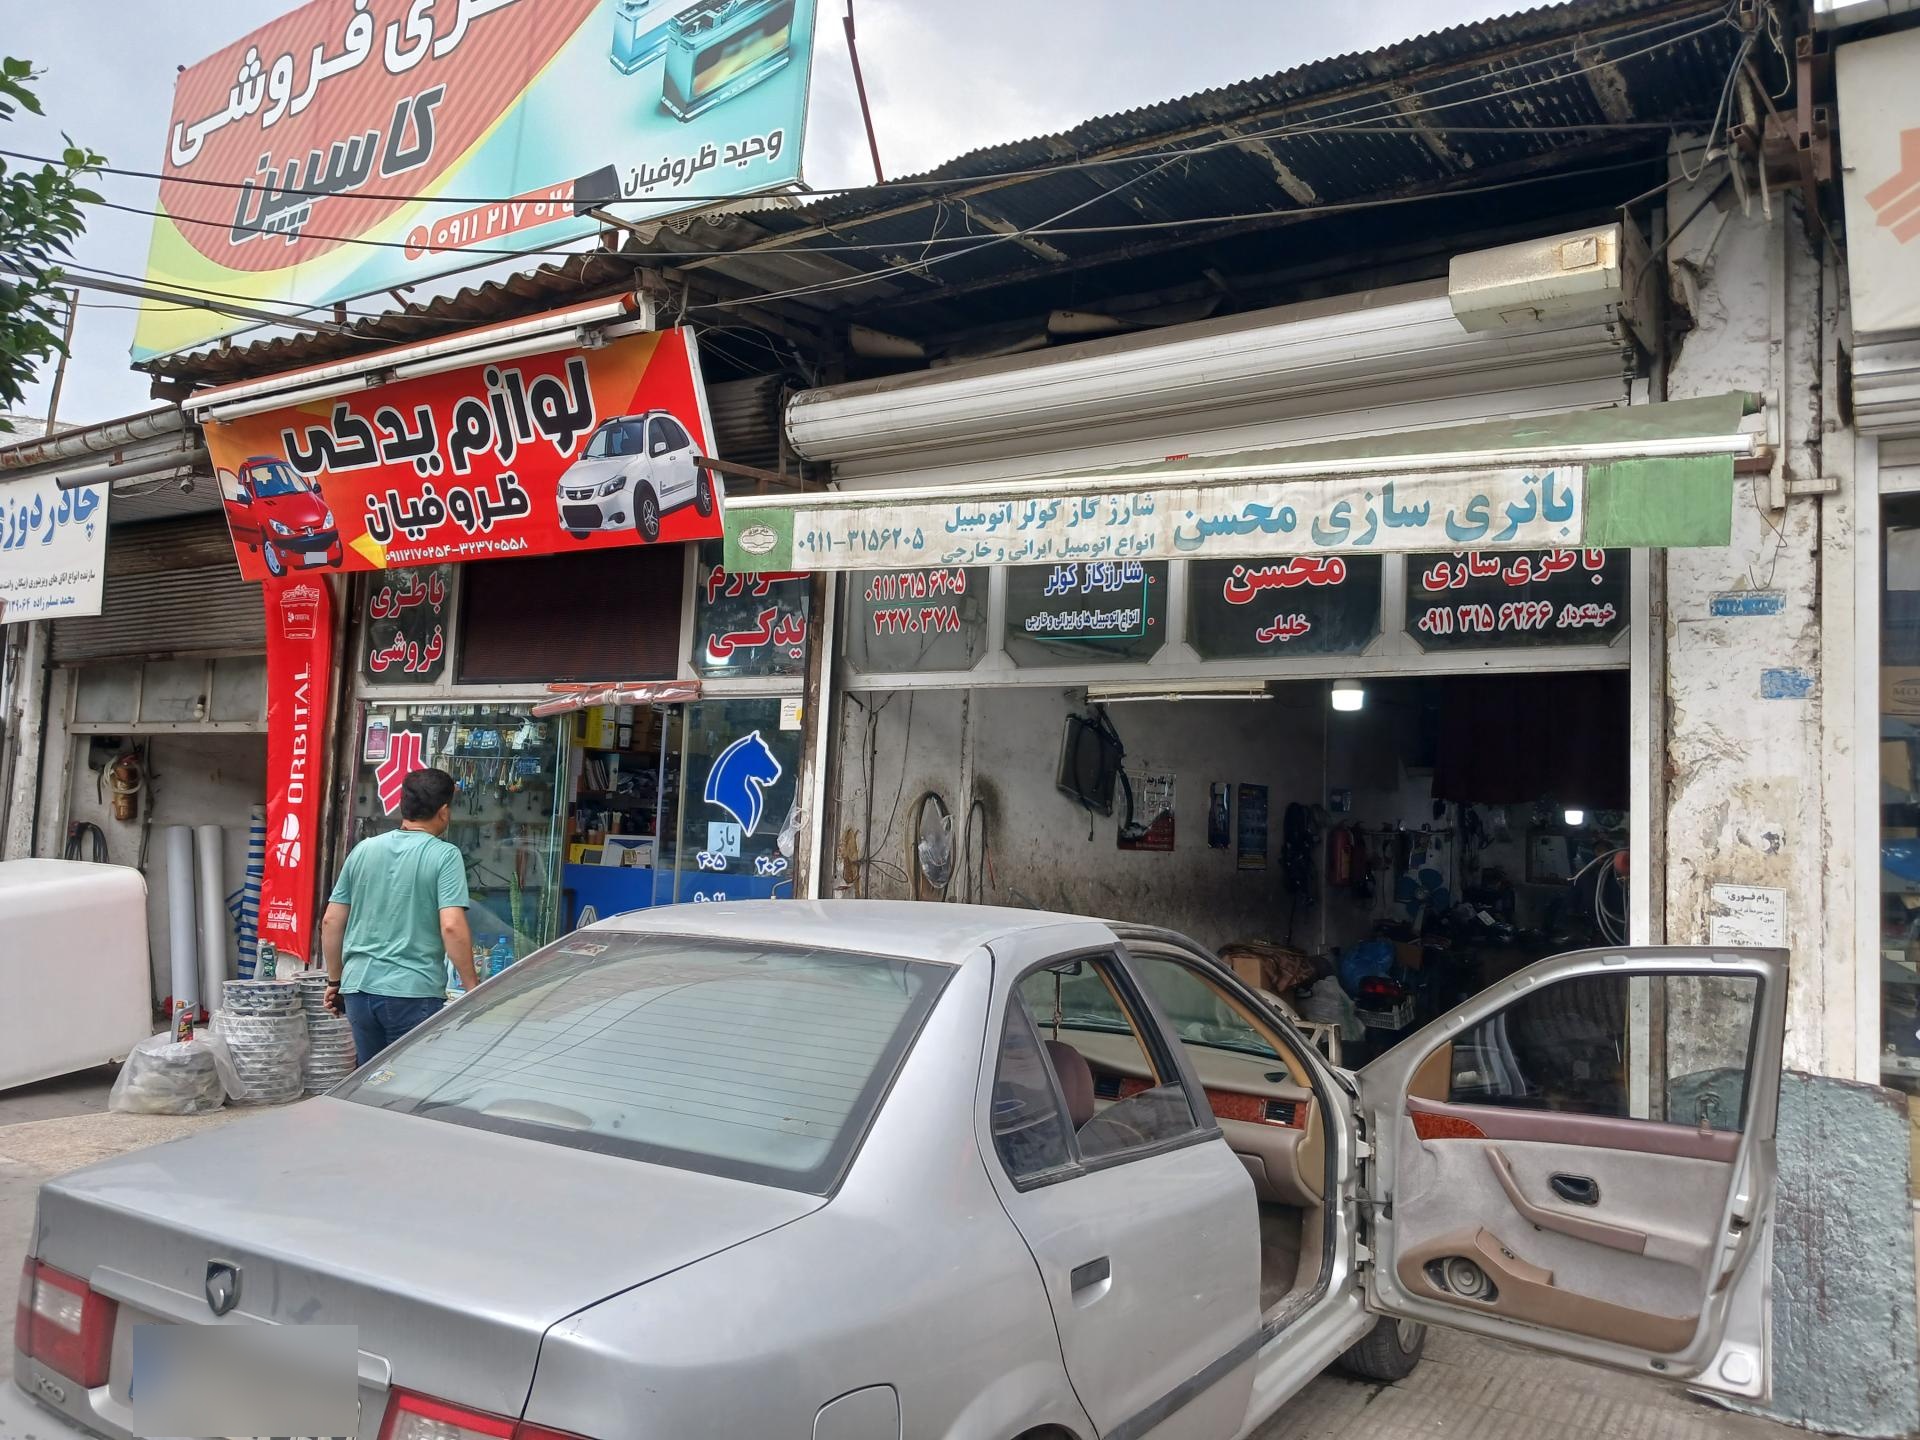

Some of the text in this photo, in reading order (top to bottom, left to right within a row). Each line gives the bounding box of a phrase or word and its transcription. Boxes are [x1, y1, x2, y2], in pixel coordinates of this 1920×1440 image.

[171, 0, 374, 168] فروشی
[228, 83, 447, 248] کاسپین
[624, 130, 782, 197] وحید ظروفیان
[281, 356, 596, 477] لوازم یدکی
[0, 493, 42, 549] دوز
[364, 471, 531, 544] ظروفیان
[945, 494, 1155, 533] شارژ گاز کولر اتومبیل
[1174, 472, 1573, 551] باتری سازی محسن
[798, 527, 924, 553] ۰۹۱۱-۳۱۵۶۲۰۵
[941, 533, 1155, 563] انواع اتومبیل ایرانی و خارجی
[369, 570, 446, 619] باطری
[865, 568, 966, 601] ۰۹۱۱ ۳۱۵ ۶۲۰۵
[1044, 564, 1077, 596] کولر
[1223, 555, 1346, 604] محسن
[707, 606, 807, 659] یدکی
[873, 606, 961, 635] ۳۲۷۰۳۷۸
[1256, 613, 1311, 643] خلیلی
[1418, 601, 1617, 634] خوشکردار ۰۹۱۱ ۳۱۵ ۶۲۶۶
[369, 623, 444, 674] فروشی
[287, 662, 309, 804] ORBITAL
[696, 852, 726, 870] ۴۰۵
[714, 825, 735, 853] باز
[755, 856, 787, 875] ۲۰۶
